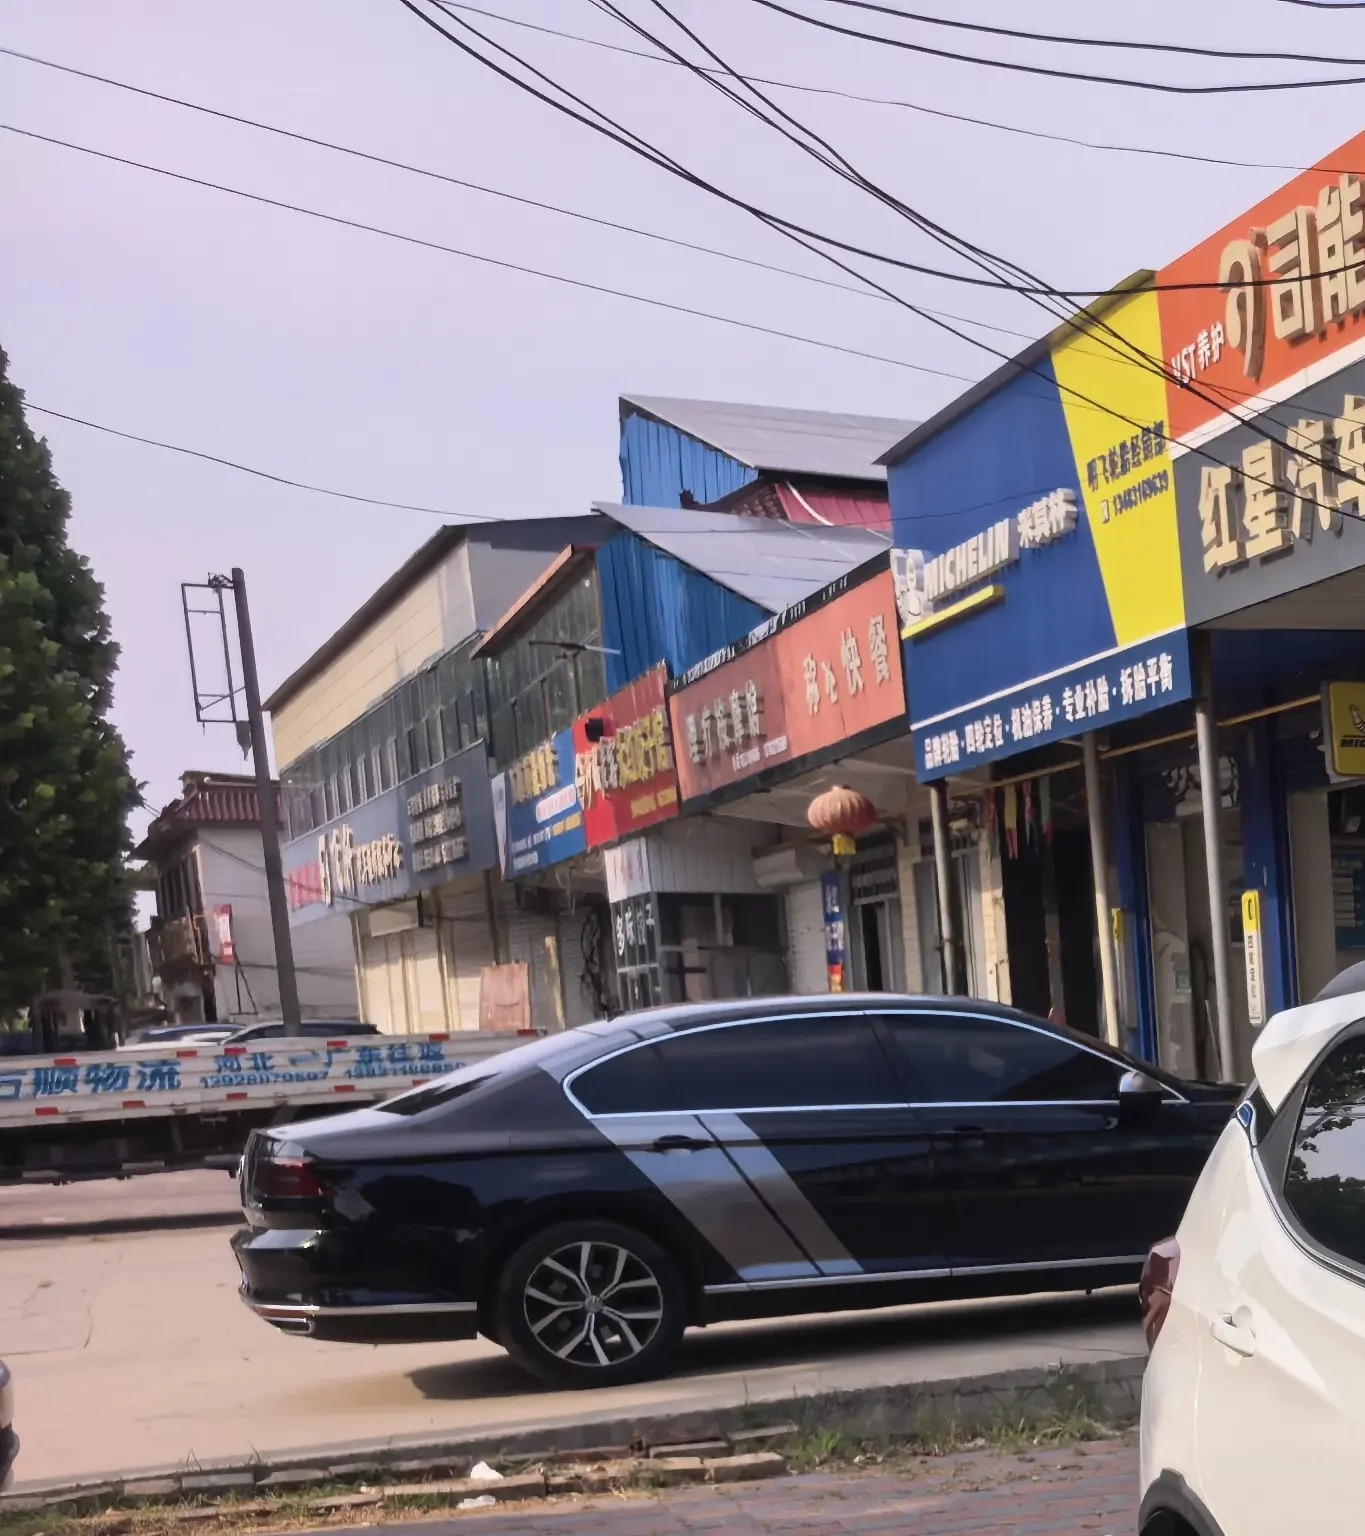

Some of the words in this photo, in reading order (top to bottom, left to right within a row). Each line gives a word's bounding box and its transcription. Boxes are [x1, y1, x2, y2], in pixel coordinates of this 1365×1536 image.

[923, 517, 1020, 602] MICHELIN
[1017, 487, 1079, 549] 米其林
